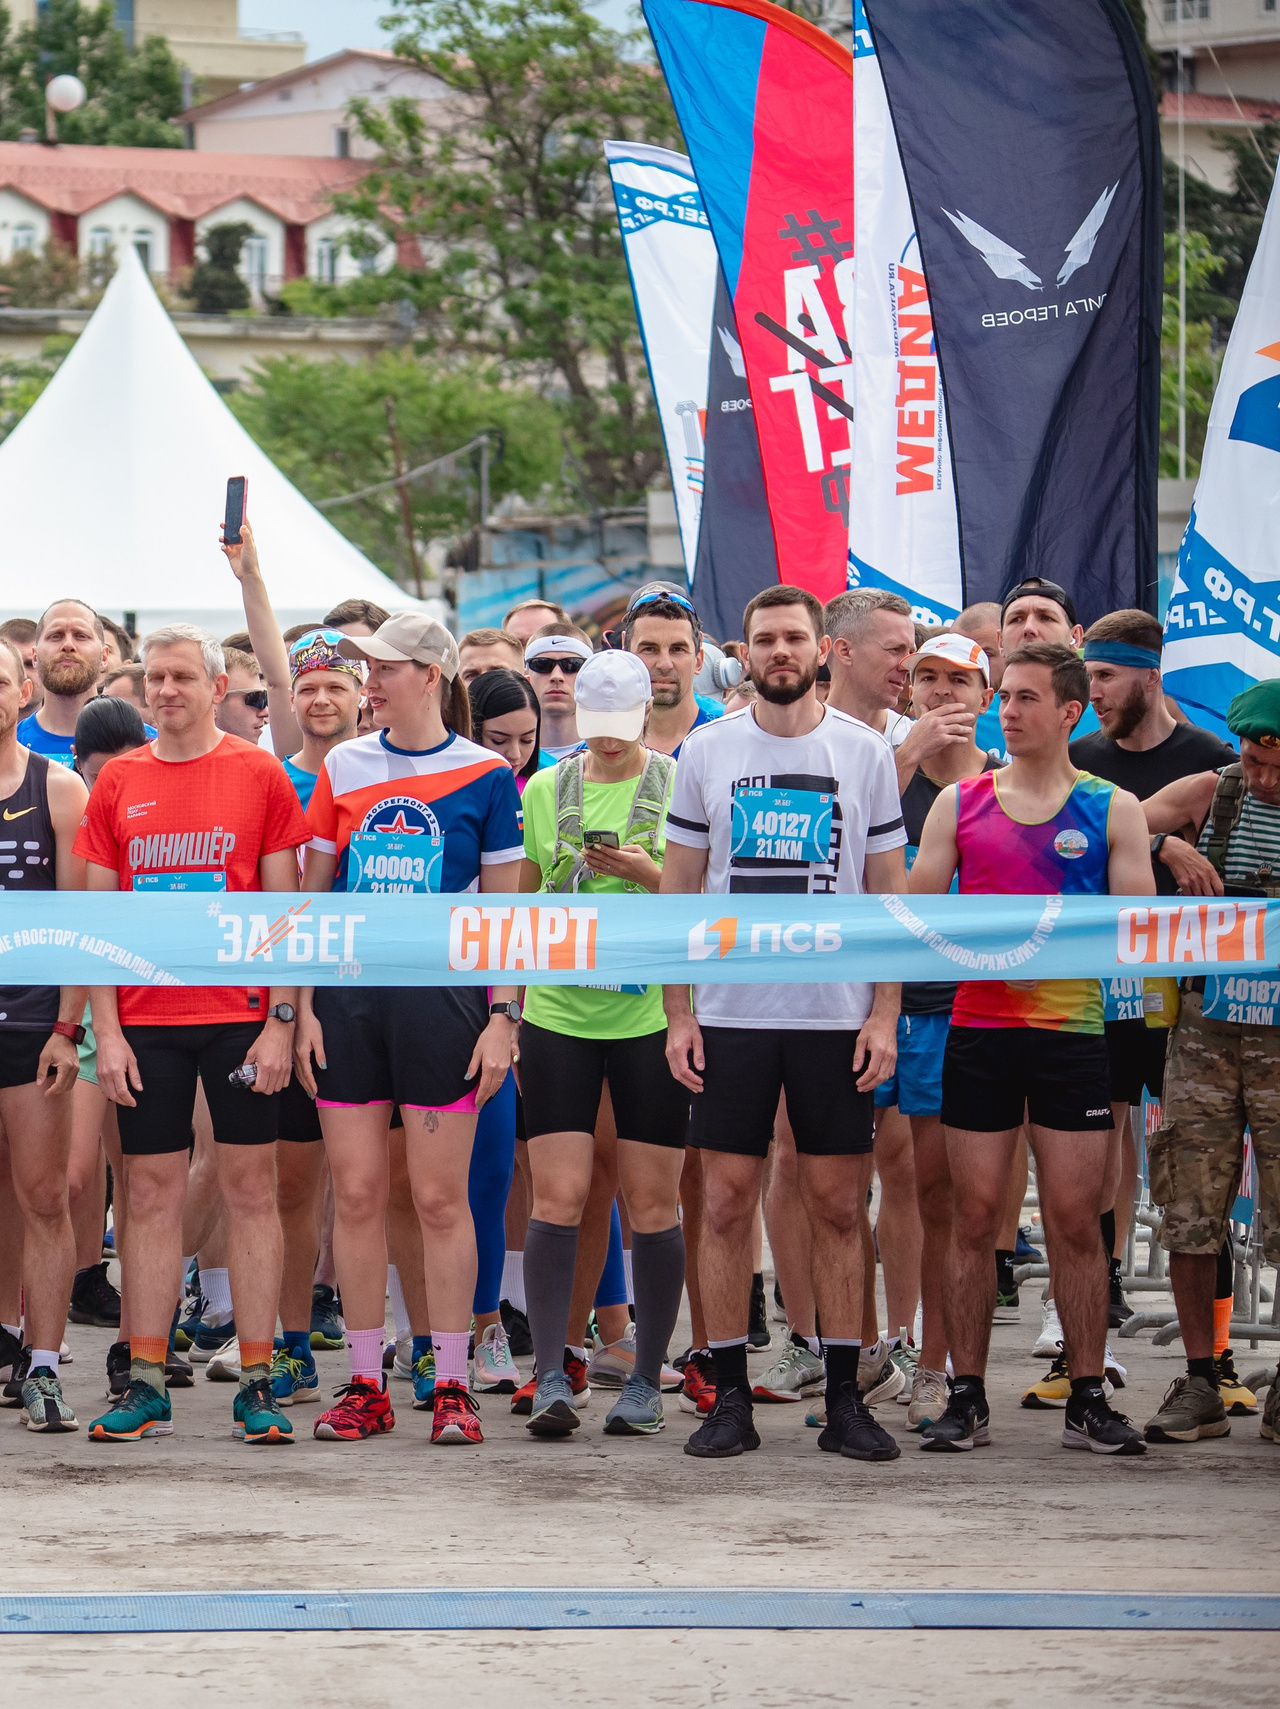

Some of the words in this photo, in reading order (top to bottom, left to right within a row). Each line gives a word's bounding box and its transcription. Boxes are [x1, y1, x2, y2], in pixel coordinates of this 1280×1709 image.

[366, 797, 436, 825] МОСРЕГИОНГАЗ
[751, 810, 812, 838] 40127
[128, 826, 236, 870] ФИНИШЁР
[363, 854, 425, 881] 40003
[448, 906, 598, 971] СТАРТ
[750, 922, 843, 953] ПСБ
[1117, 902, 1268, 964] СТАРТ
[13, 927, 79, 948] #ВОСТОРГ
[79, 934, 157, 981] #АДРЕНАЛИН
[1223, 976, 1280, 1004] 40187
